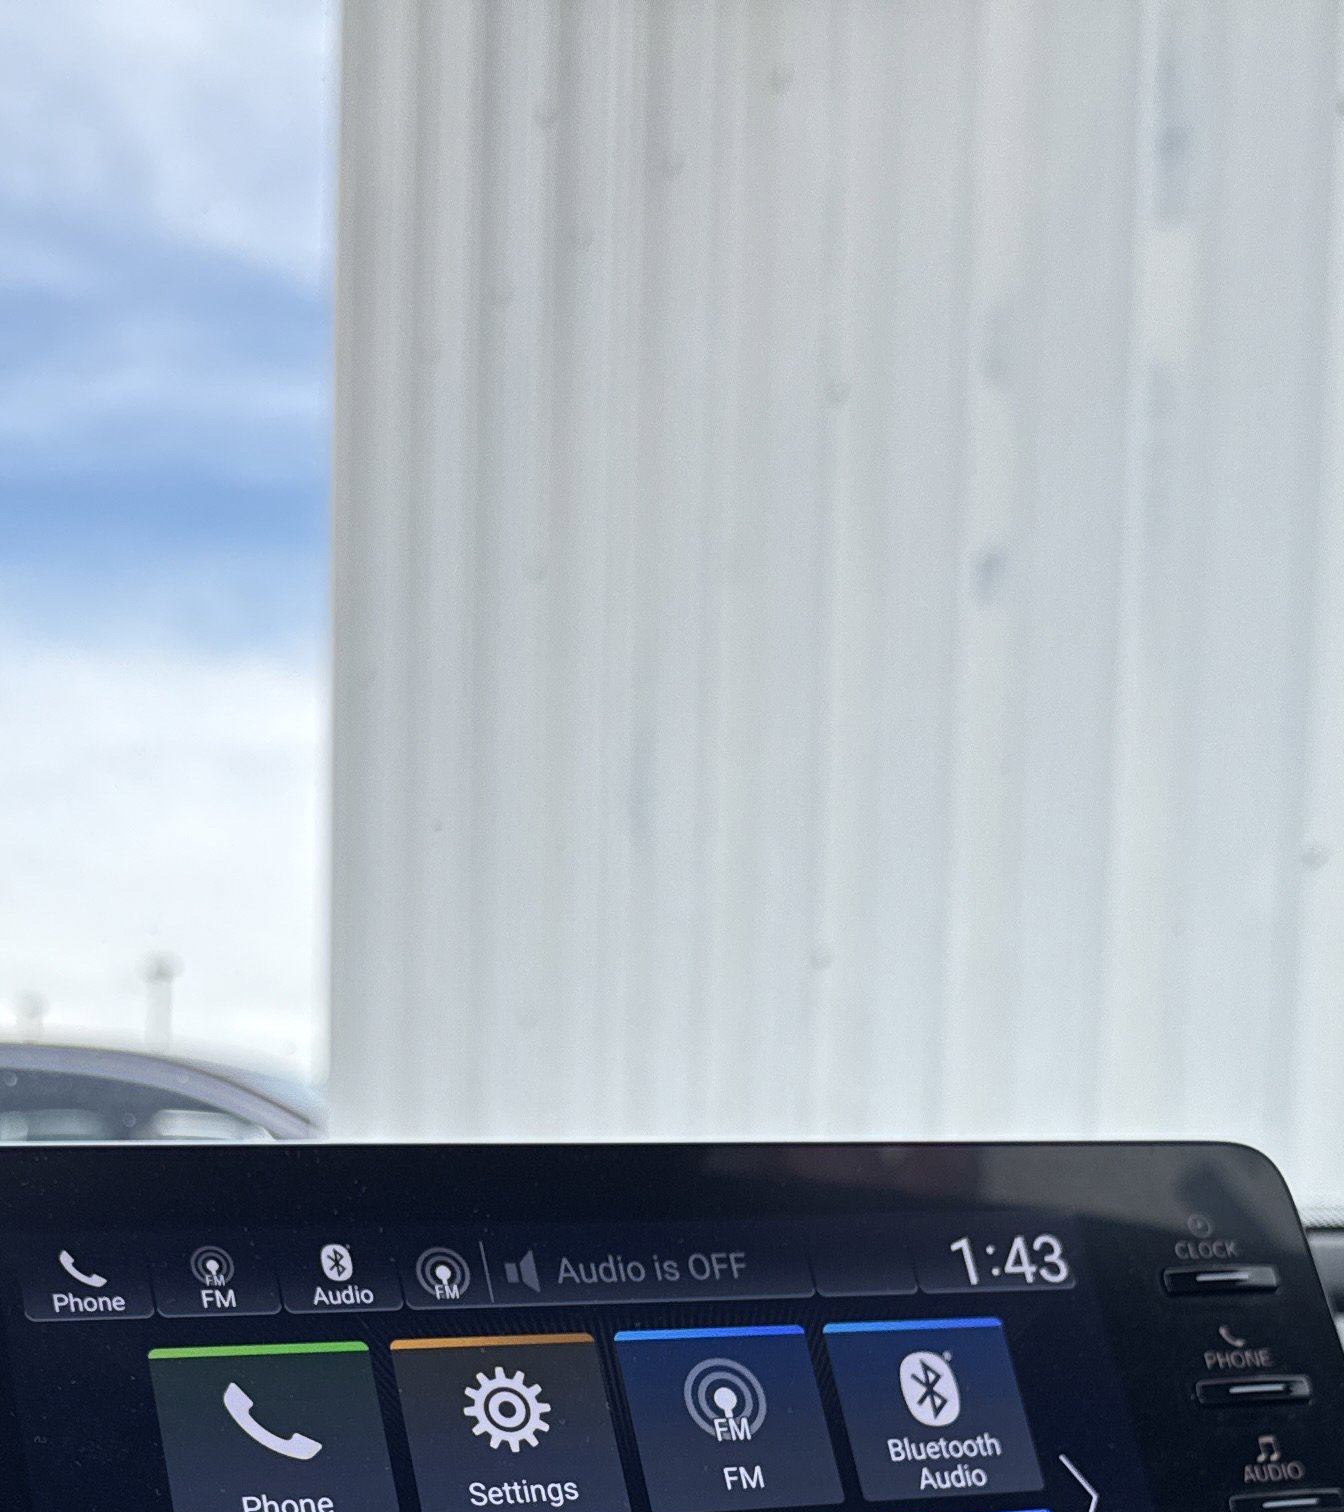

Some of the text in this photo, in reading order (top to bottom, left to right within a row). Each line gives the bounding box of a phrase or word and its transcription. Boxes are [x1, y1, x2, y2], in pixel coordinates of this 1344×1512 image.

[950, 1234, 1069, 1286] 1:43
[1174, 1241, 1238, 1260] CLOCK
[558, 1251, 747, 1285] Audio is OFF
[206, 1274, 226, 1287] FM
[52, 1292, 126, 1313] Phone
[200, 1289, 236, 1309] FM
[313, 1285, 374, 1307] Audio
[435, 1284, 460, 1300] FM
[1204, 1350, 1272, 1369] PHONE
[714, 1417, 752, 1442] FM
[887, 1432, 1002, 1463] Bluetooth
[723, 1465, 766, 1490] FM
[919, 1464, 987, 1490] Audio
[1244, 1462, 1304, 1482] AUDIO
[469, 1480, 579, 1508] Settings
